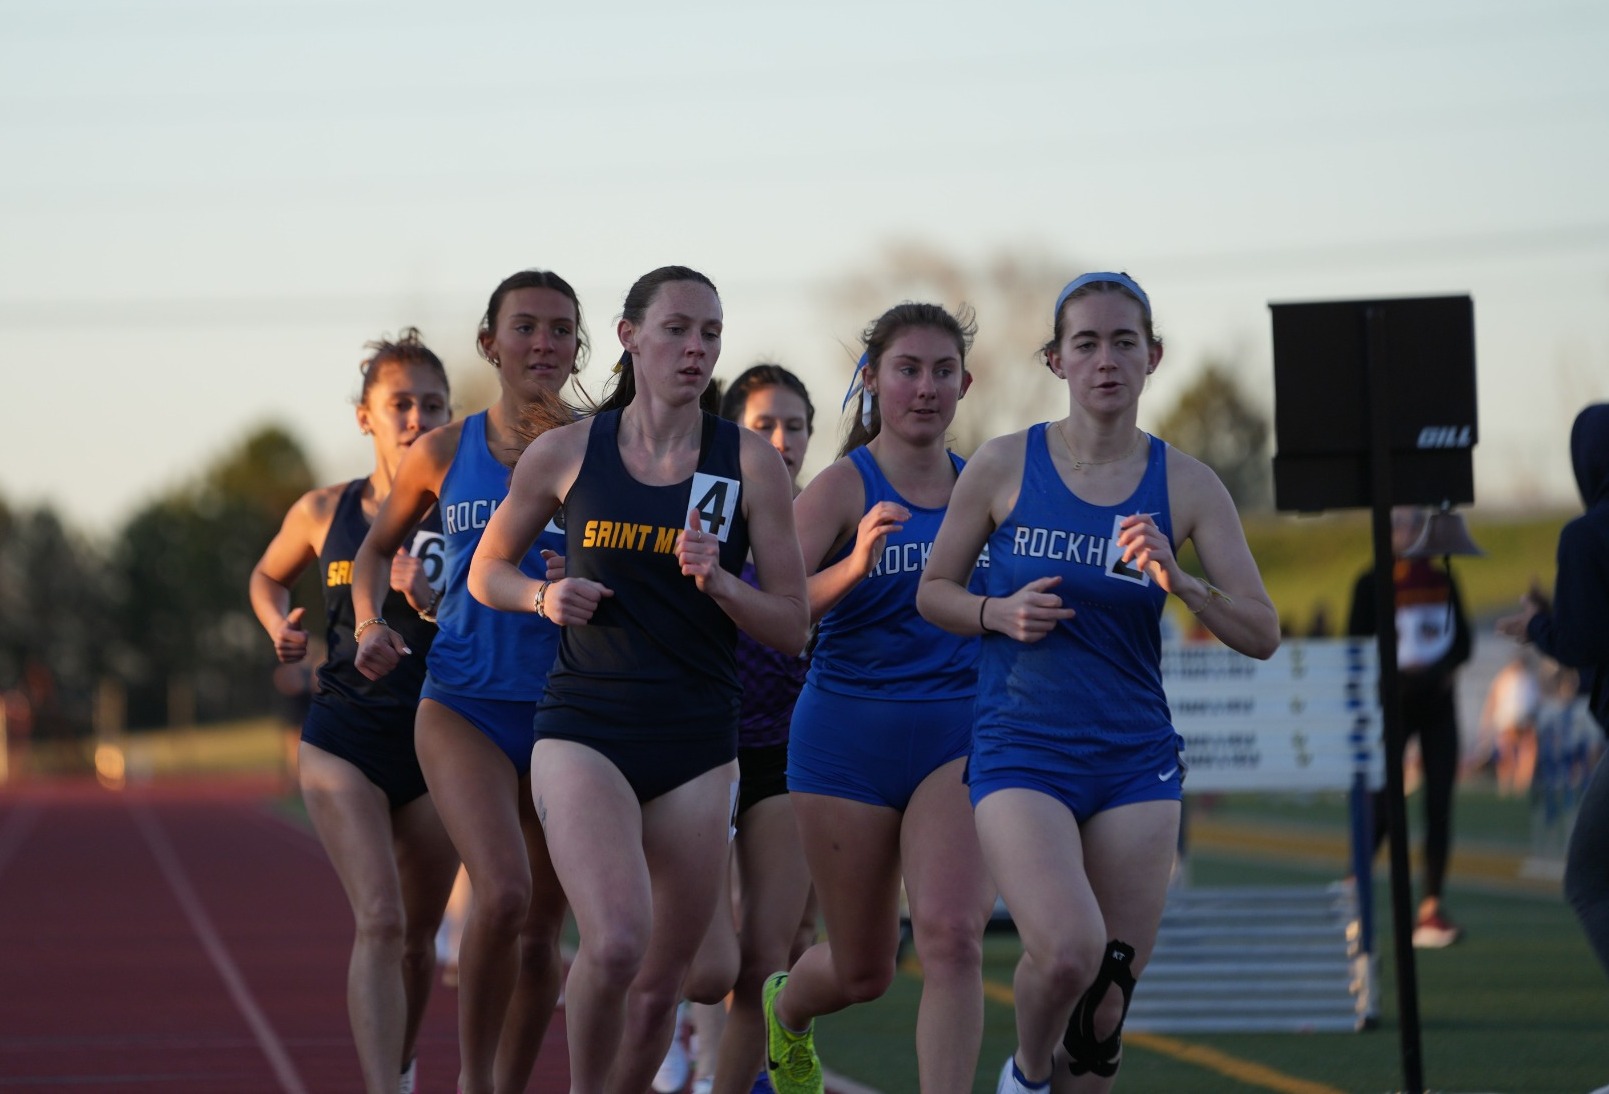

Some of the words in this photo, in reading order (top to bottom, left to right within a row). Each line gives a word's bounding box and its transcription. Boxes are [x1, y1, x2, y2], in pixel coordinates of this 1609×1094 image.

[1417, 425, 1470, 448] GILL
[695, 480, 726, 535] 4
[583, 520, 652, 551] SAINT
[418, 538, 445, 583] 6
